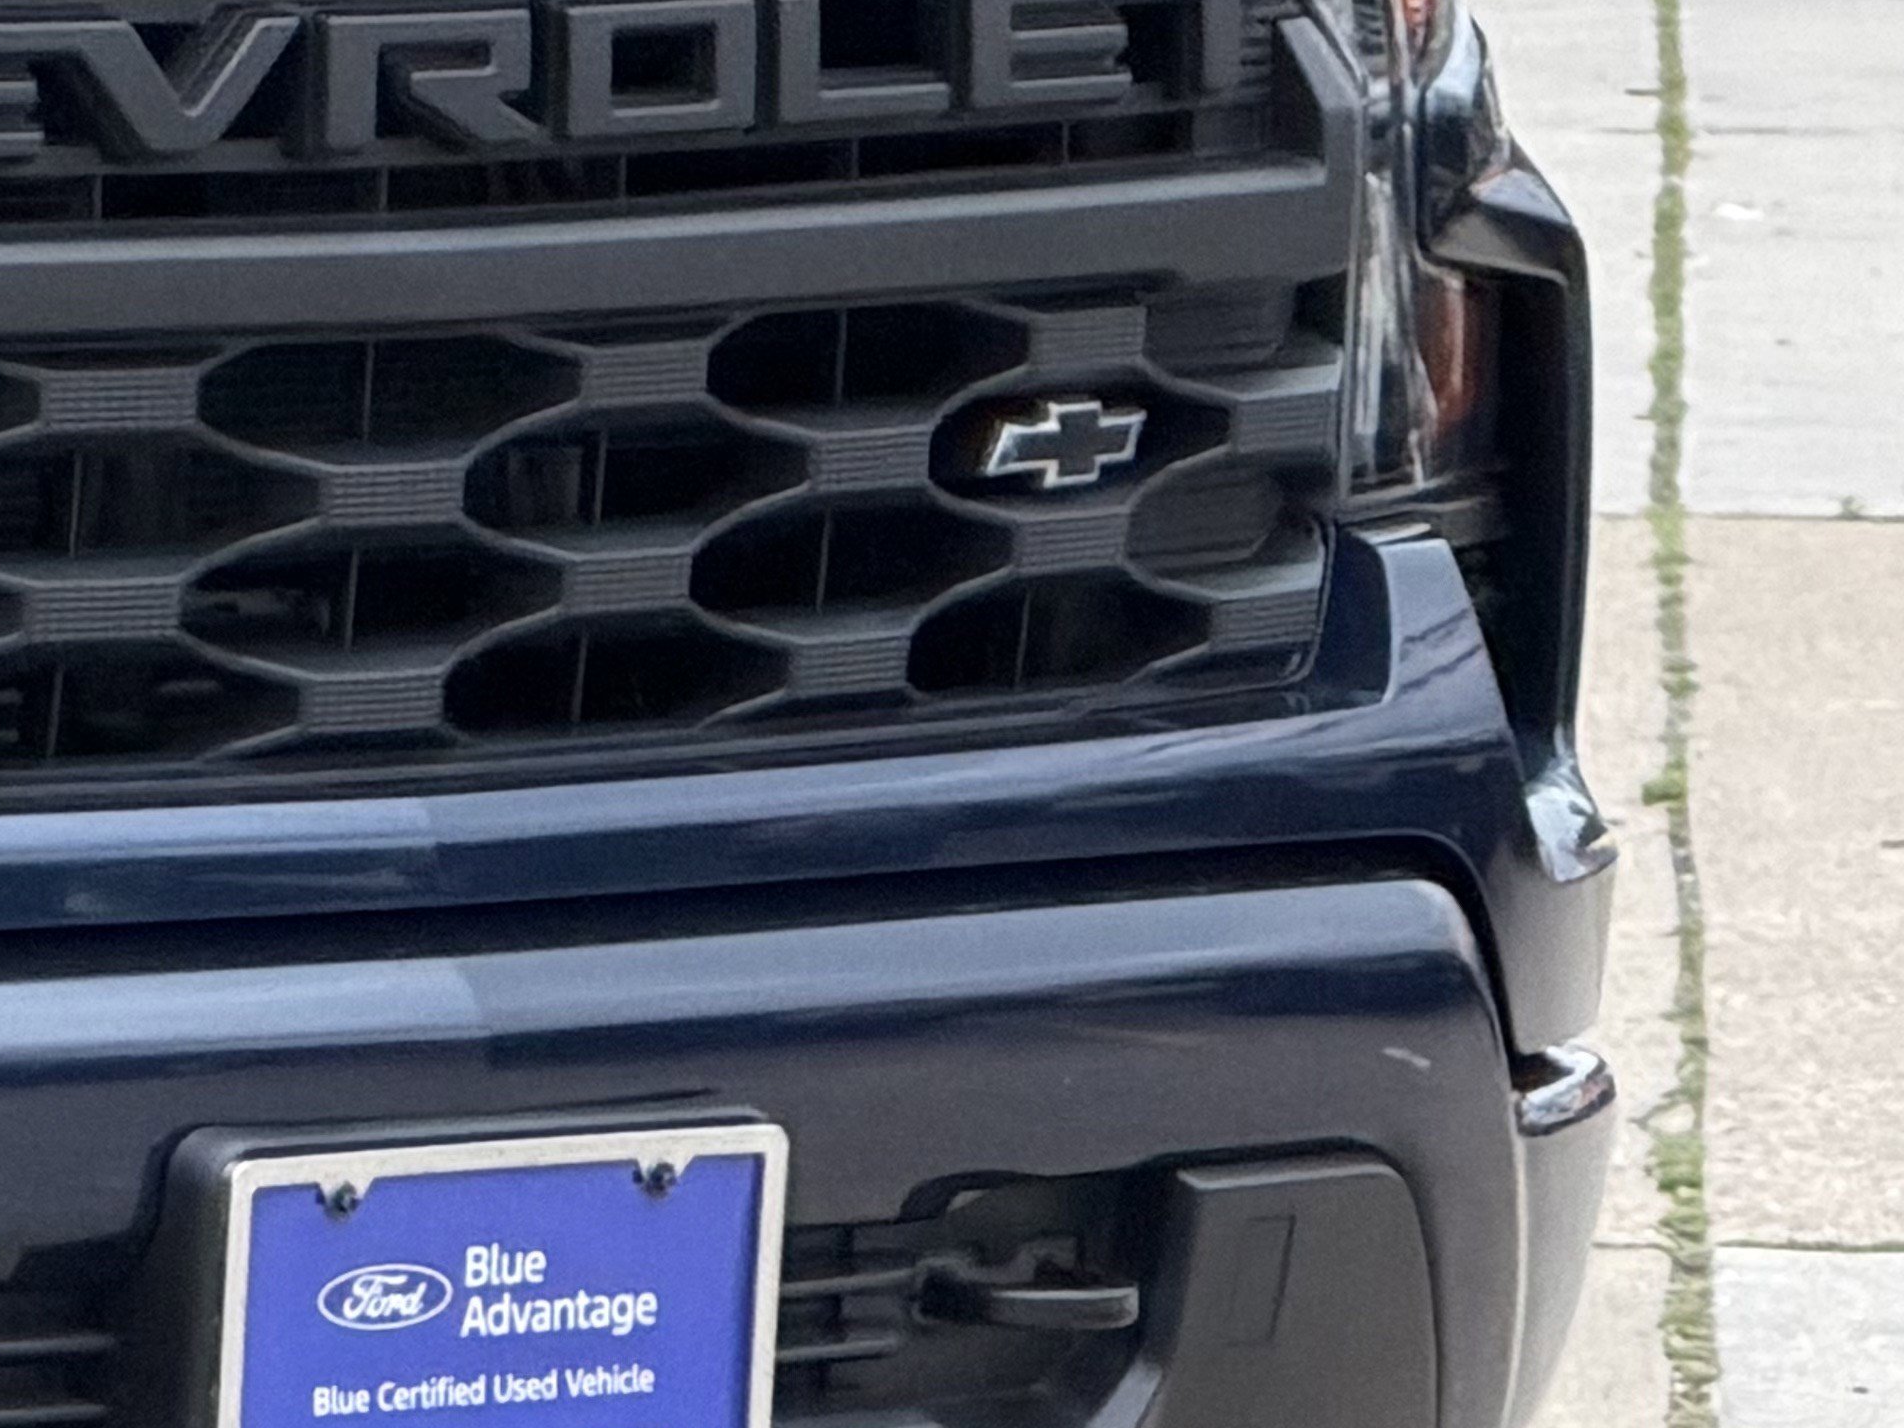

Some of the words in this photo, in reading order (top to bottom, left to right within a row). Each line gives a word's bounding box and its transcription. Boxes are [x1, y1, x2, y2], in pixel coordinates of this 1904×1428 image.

[465, 1242, 547, 1288] Blue
[460, 1289, 658, 1338] Advantage
[313, 1385, 370, 1417] Blue
[377, 1375, 486, 1412] Certified
[493, 1368, 558, 1404] Used
[565, 1363, 655, 1398] Vehicle
